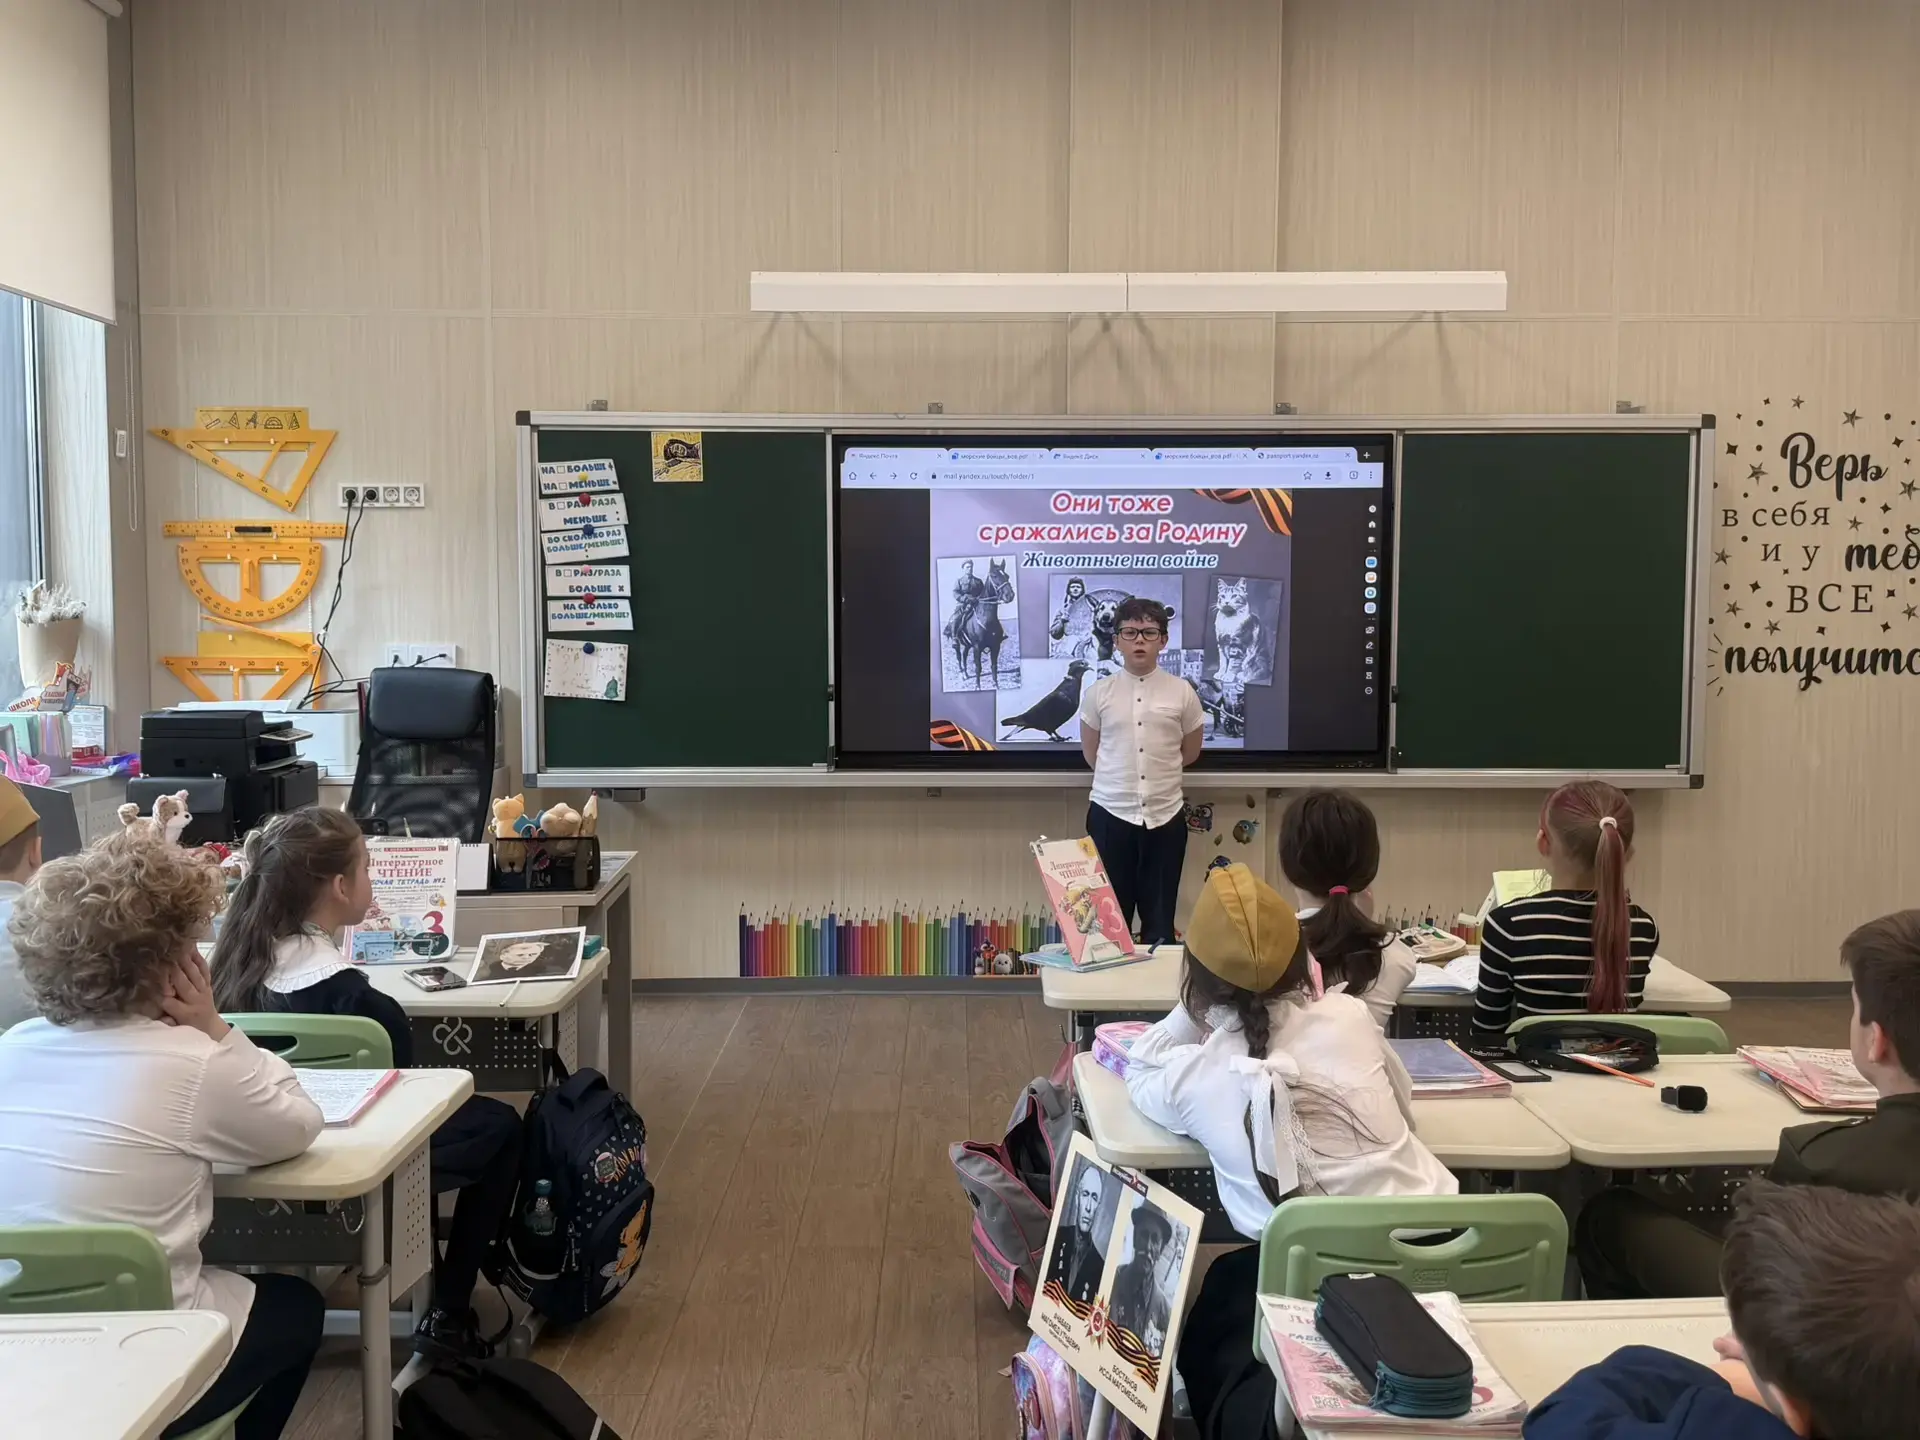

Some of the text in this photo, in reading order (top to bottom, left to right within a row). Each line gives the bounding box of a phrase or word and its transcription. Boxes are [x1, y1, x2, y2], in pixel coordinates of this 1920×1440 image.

[541, 466, 555, 474] НА
[567, 463, 607, 473] БОЛЬШЕ
[1780, 432, 1888, 501] Верь
[569, 479, 611, 489] МЕНЬШЕ
[548, 502, 555, 510] В
[1052, 492, 1172, 512] Они тоже
[563, 514, 608, 525] МЕНЬШЕ
[1722, 501, 1830, 527] в себя
[547, 529, 621, 544] ВО СКОЛЬКО РАЗ
[979, 521, 1246, 547] сражались за Родину
[547, 539, 625, 553] БОЛЬШЕ/МЕНЬШЕ?
[1761, 524, 1920, 572] и у теб
[1022, 550, 1218, 568] Животные на войне
[555, 569, 562, 577] В
[569, 585, 612, 593] БОЛЬШЕ
[1786, 583, 1873, 613] ВСЕ
[578, 602, 619, 610] СКОЛЬКО
[551, 612, 630, 620] БОЛЬШЕ/МЕНЬШЕ?
[1724, 645, 1920, 692] получитс
[8, 697, 37, 712] ШКОЛА
[377, 867, 432, 878] ЧТЕНИЕ
[1101, 897, 1122, 933] 3
